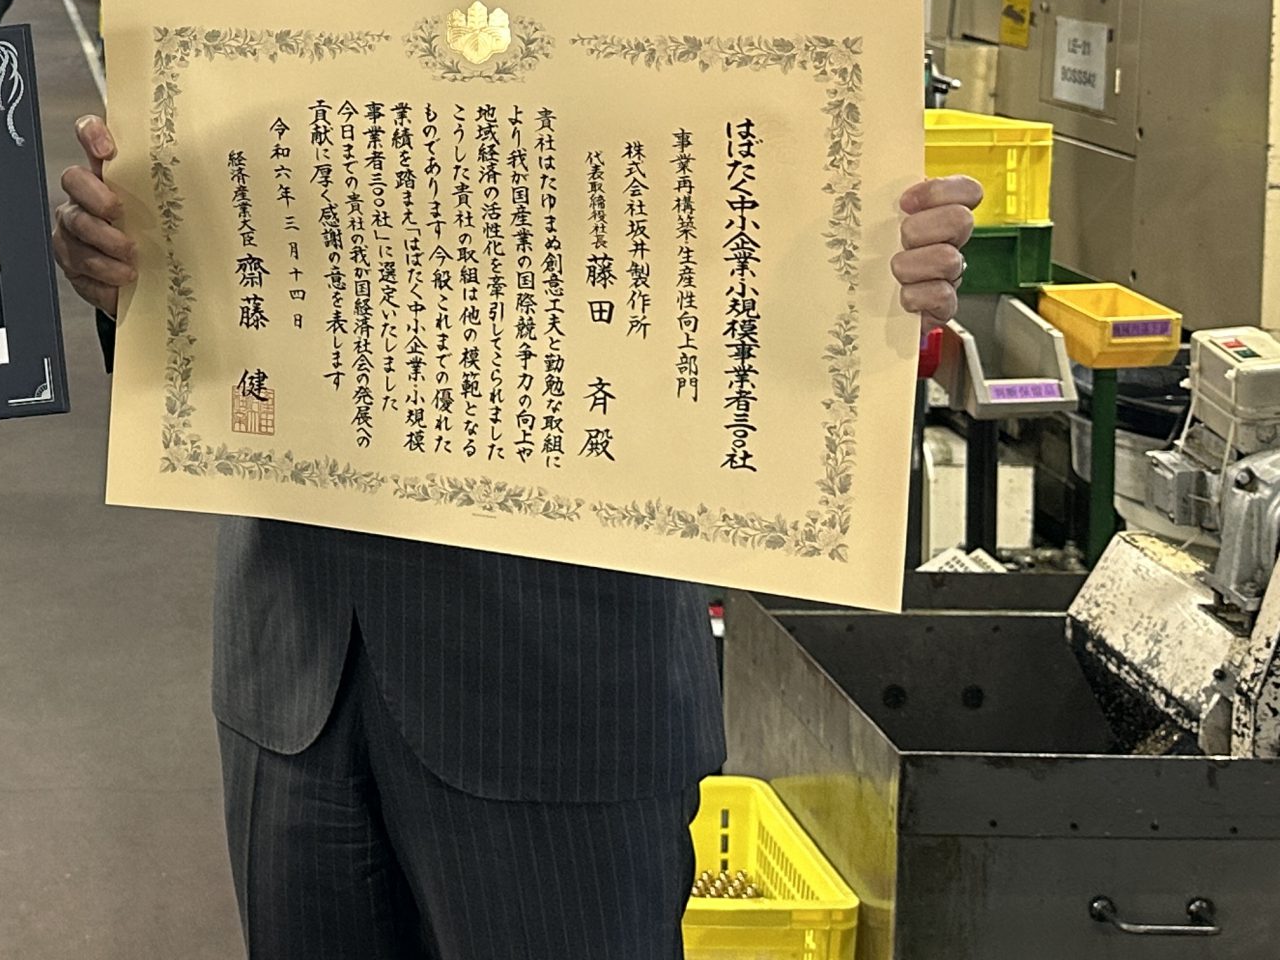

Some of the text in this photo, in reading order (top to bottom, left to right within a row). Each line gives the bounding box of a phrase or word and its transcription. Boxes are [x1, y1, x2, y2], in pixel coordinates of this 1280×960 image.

[227, 149, 258, 248] 経済産業大臣
[308, 98, 348, 391] 貢献に厚く感謝の意を表します
[451, 103, 483, 458] こうした貴社の取組は他の模範となる
[506, 104, 538, 463] より我が国産業の国際競争力の向上や
[584, 251, 618, 325] 藤田
[621, 140, 652, 340] 株式会社坂井製作所
[577, 428, 616, 462] 殿
